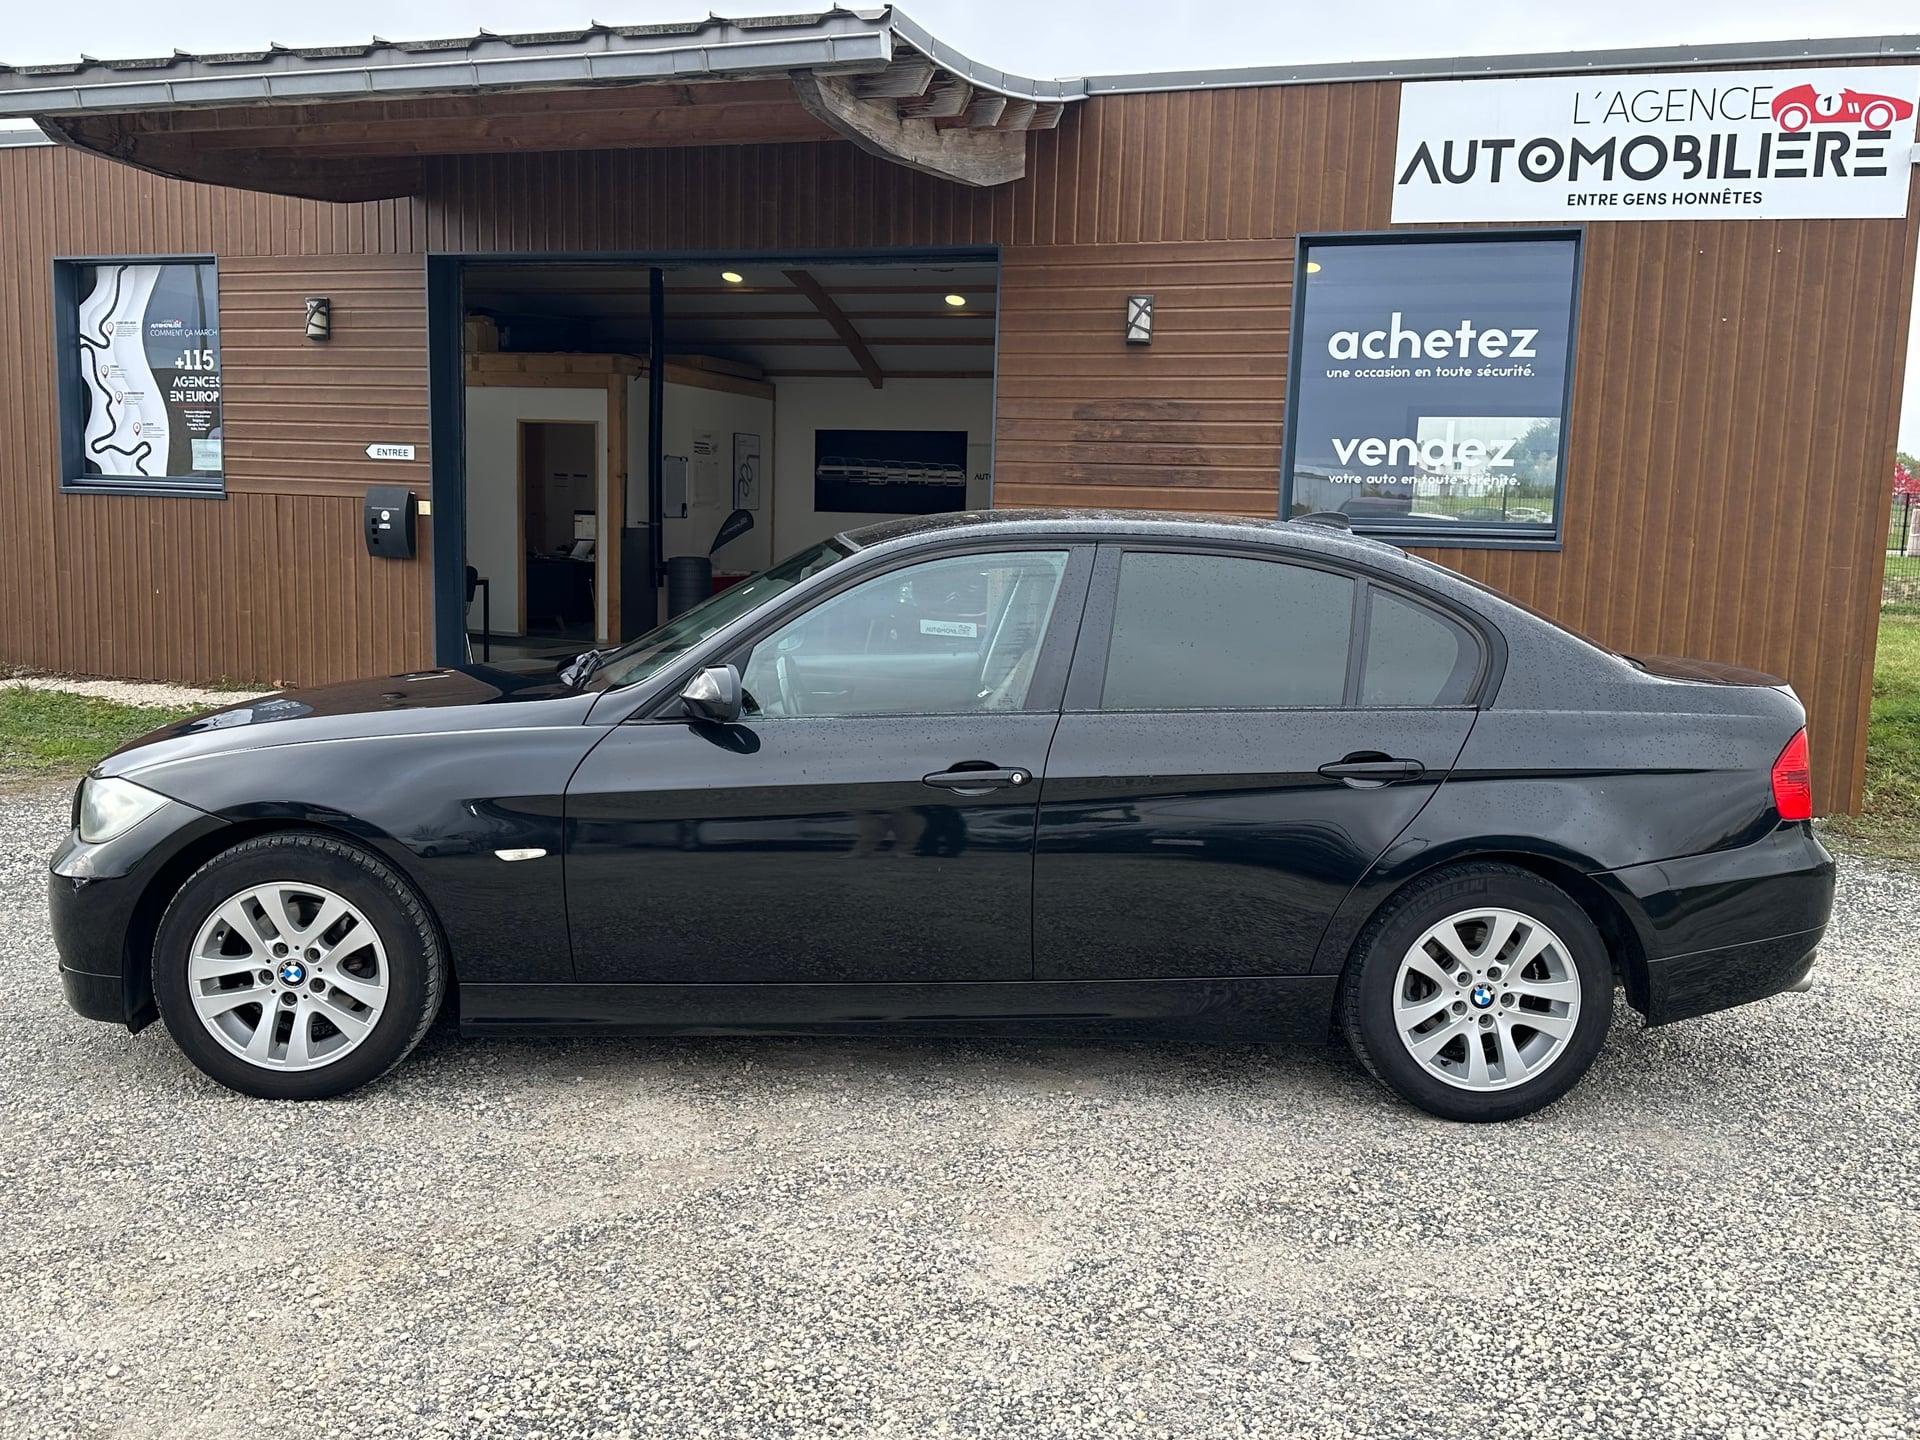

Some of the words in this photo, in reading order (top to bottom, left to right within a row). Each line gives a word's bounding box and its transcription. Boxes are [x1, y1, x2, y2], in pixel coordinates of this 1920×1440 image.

[1823, 96, 1833, 111] 1
[1566, 192, 1620, 207] ENTRE
[1622, 191, 1667, 206] GENS
[1671, 187, 1763, 205] HONNÊTES
[150, 329, 184, 337] COMMENT
[184, 329, 194, 338] ÇA
[1327, 311, 1539, 360] achetez
[175, 349, 214, 371] +115
[1326, 368, 1350, 378] une
[1354, 365, 1410, 378] occasion
[1414, 367, 1431, 377] en
[1435, 365, 1473, 377] toute
[1476, 363, 1535, 377] sécurité.
[170, 390, 184, 402] EN
[1331, 419, 1516, 467] vendez
[1328, 473, 1362, 484] votre
[1366, 474, 1397, 485] auto
[1401, 476, 1416, 485] en
[1421, 474, 1458, 485] toute
[1462, 472, 1521, 486] sérénité.
